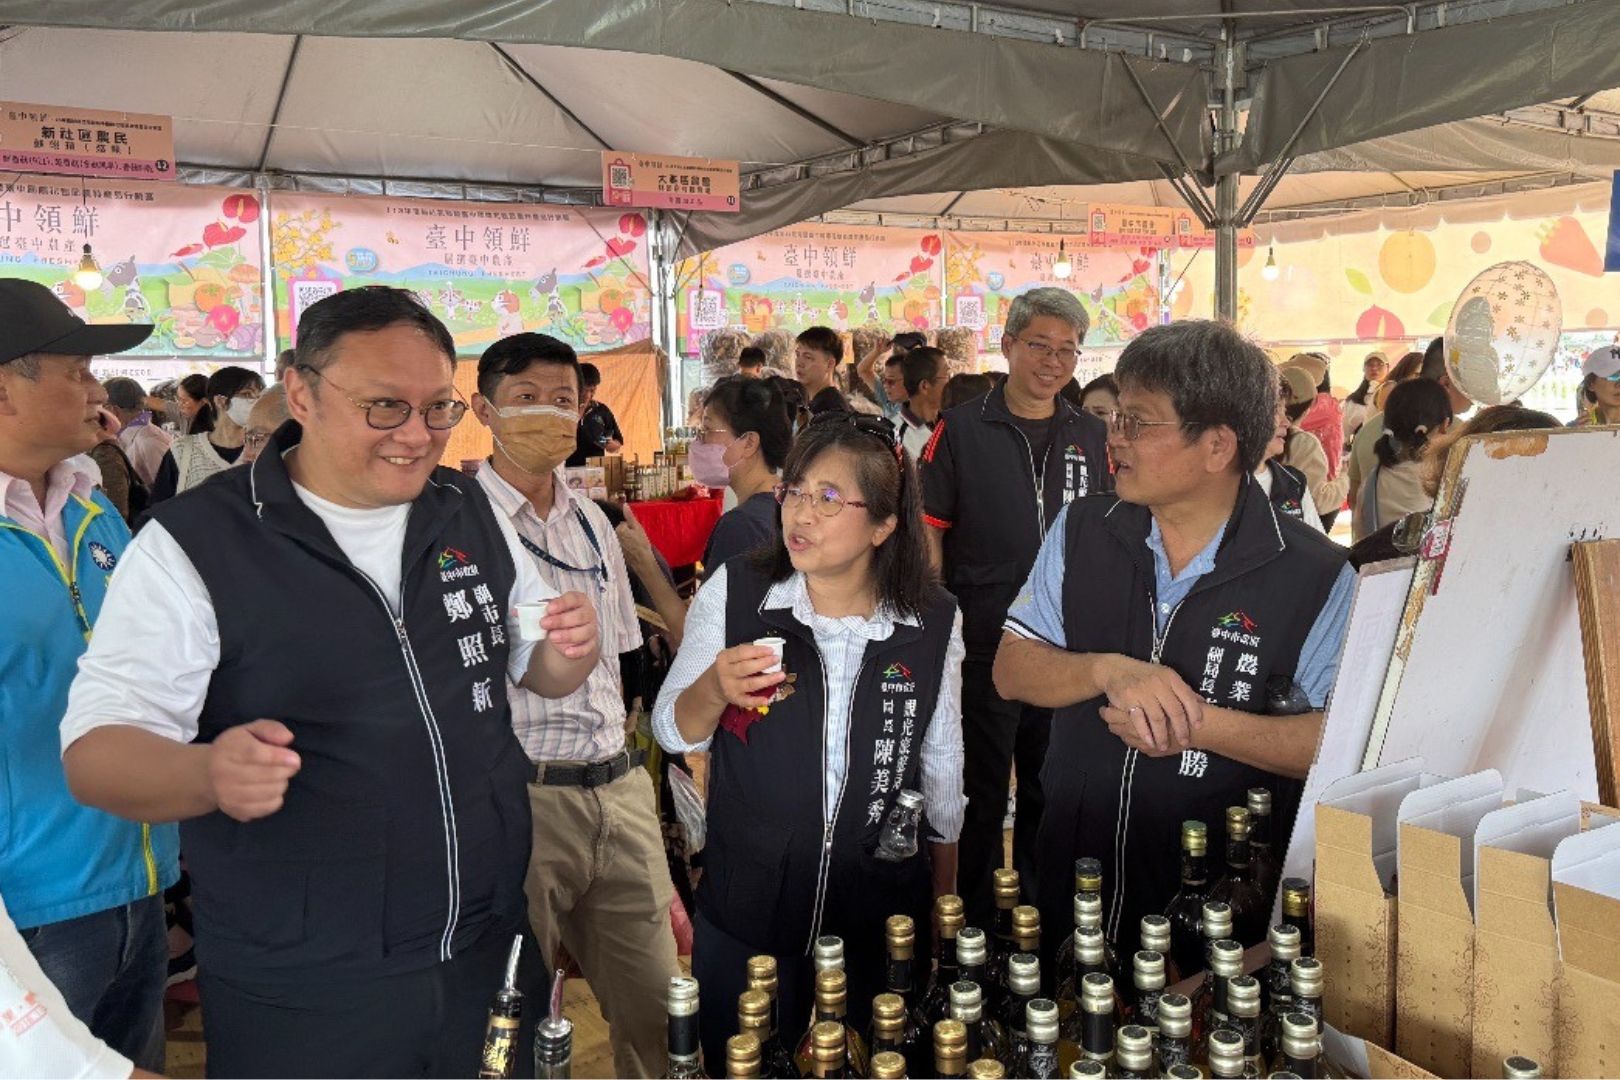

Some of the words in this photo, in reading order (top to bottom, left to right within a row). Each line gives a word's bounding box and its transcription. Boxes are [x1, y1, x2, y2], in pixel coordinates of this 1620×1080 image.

[426, 223, 531, 252] 臺中領鮮
[783, 243, 858, 268] 臺中領鮮
[472, 583, 506, 647] 副市長
[443, 588, 494, 713] 鄭照新
